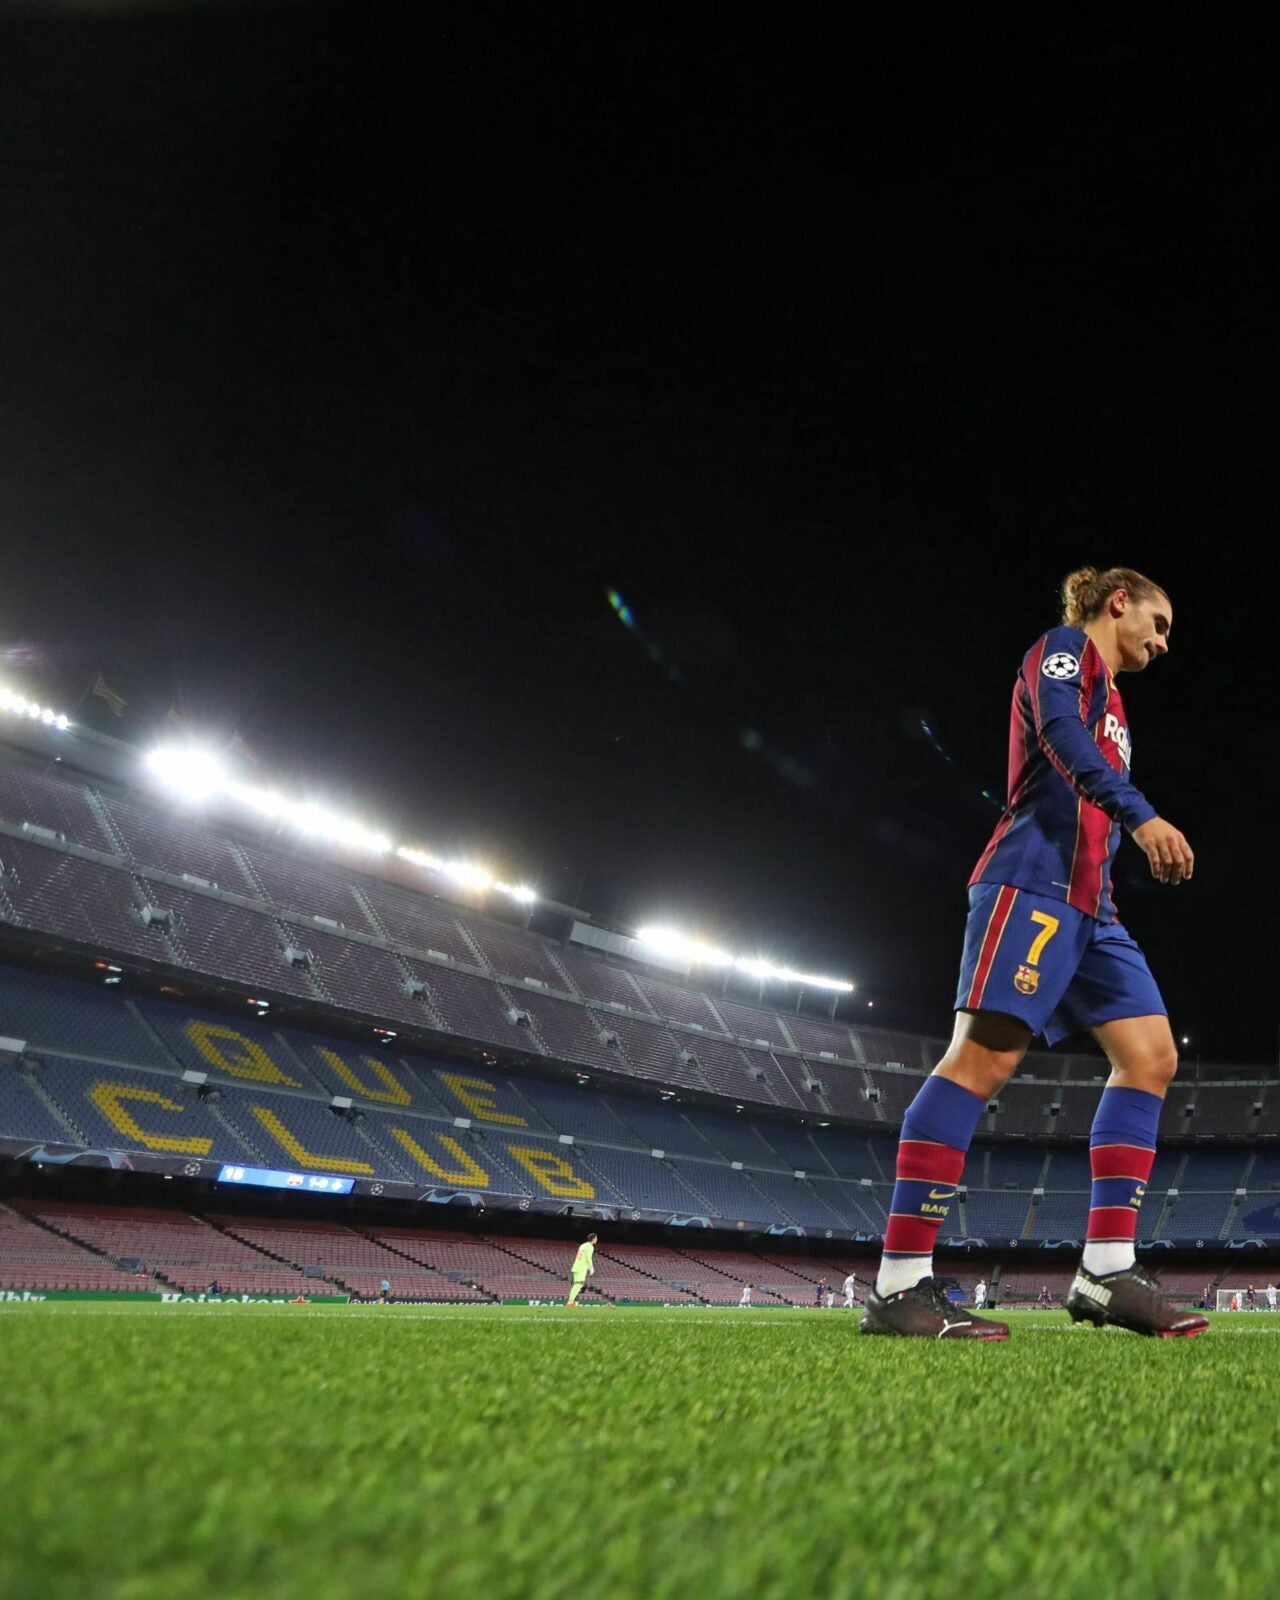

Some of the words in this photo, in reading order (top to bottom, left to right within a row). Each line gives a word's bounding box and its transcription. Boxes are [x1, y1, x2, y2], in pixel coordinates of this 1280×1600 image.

[1030, 909, 1060, 966] 7
[185, 1020, 528, 1126] QUE
[90, 1082, 595, 1199] CLUB
